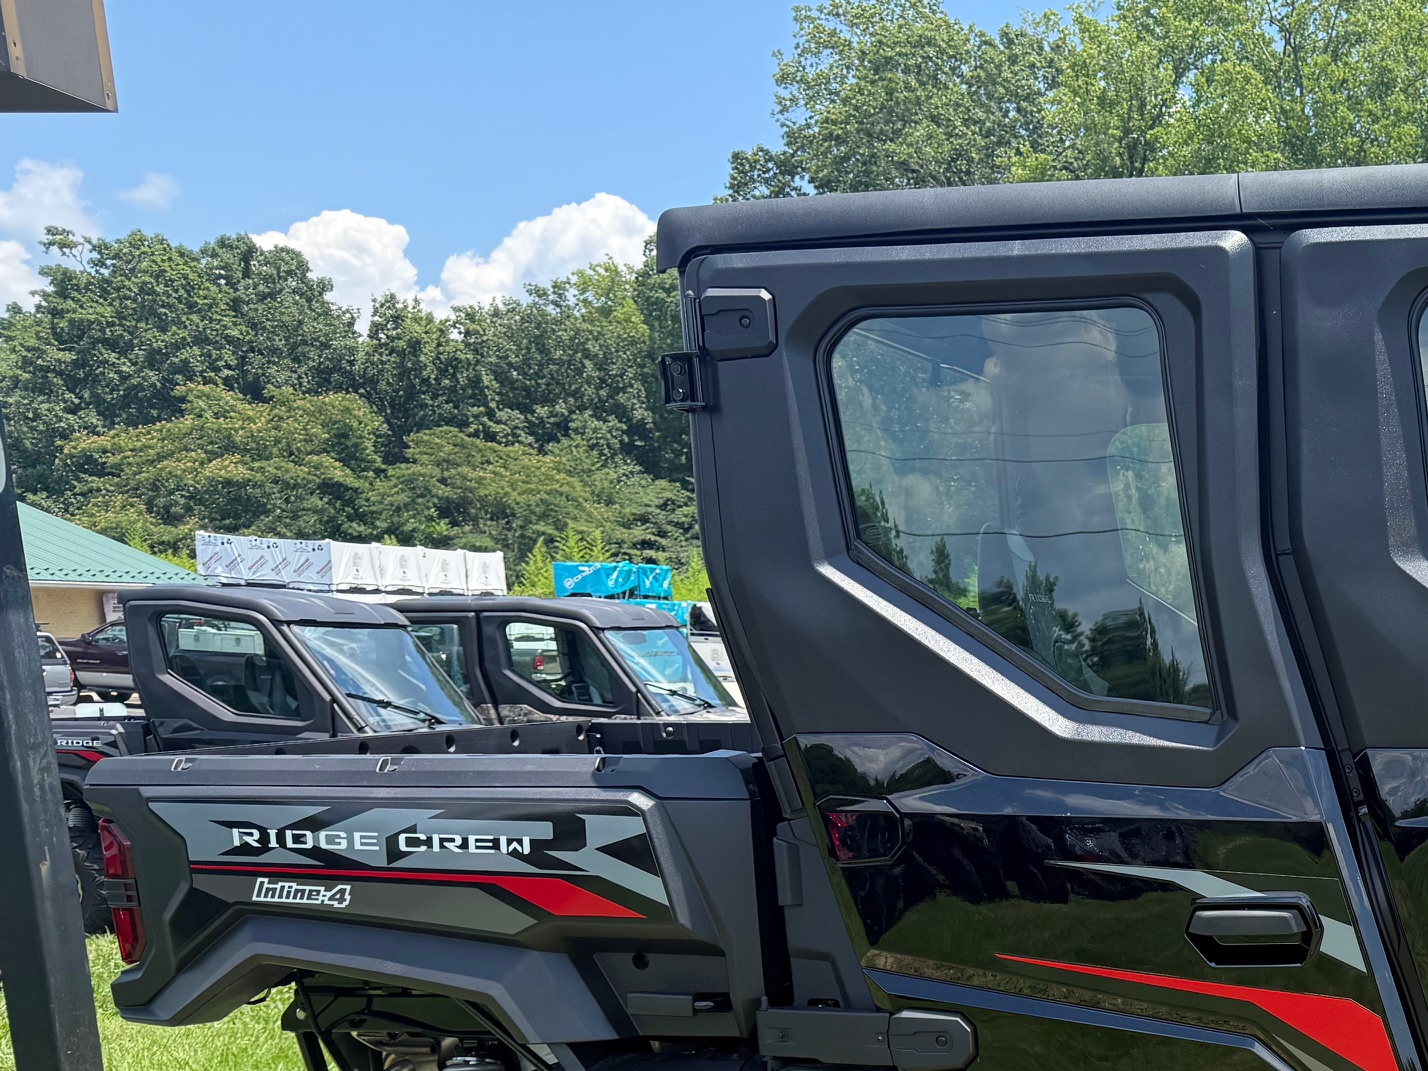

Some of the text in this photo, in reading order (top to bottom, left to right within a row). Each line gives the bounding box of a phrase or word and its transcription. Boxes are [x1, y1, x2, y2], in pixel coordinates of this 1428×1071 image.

[57, 739, 102, 747] RIDGE
[230, 828, 531, 856] RIDGE CREW
[253, 878, 351, 907] Inline-4
